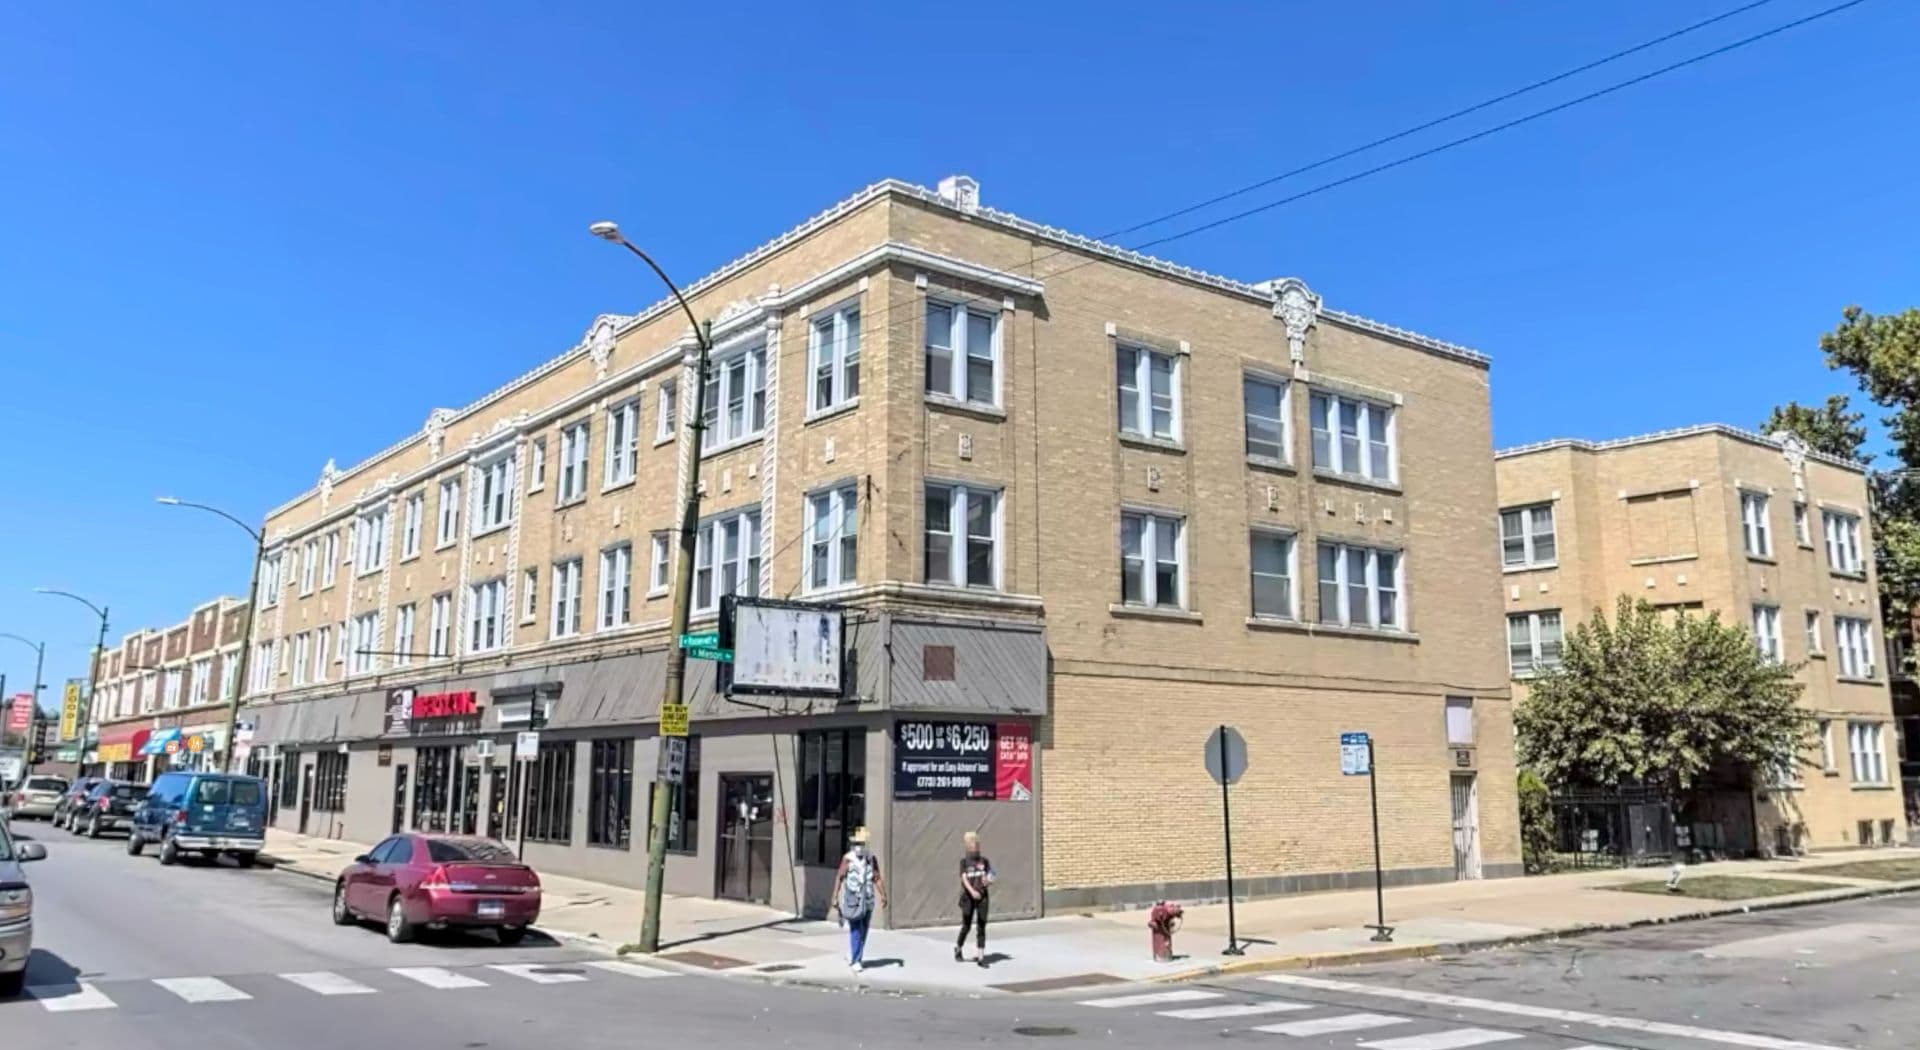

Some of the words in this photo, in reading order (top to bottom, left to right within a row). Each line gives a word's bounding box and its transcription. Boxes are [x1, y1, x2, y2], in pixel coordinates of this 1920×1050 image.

[901, 724, 934, 750] $500
[946, 725, 989, 755] $6,250
[908, 763, 930, 774] approved
